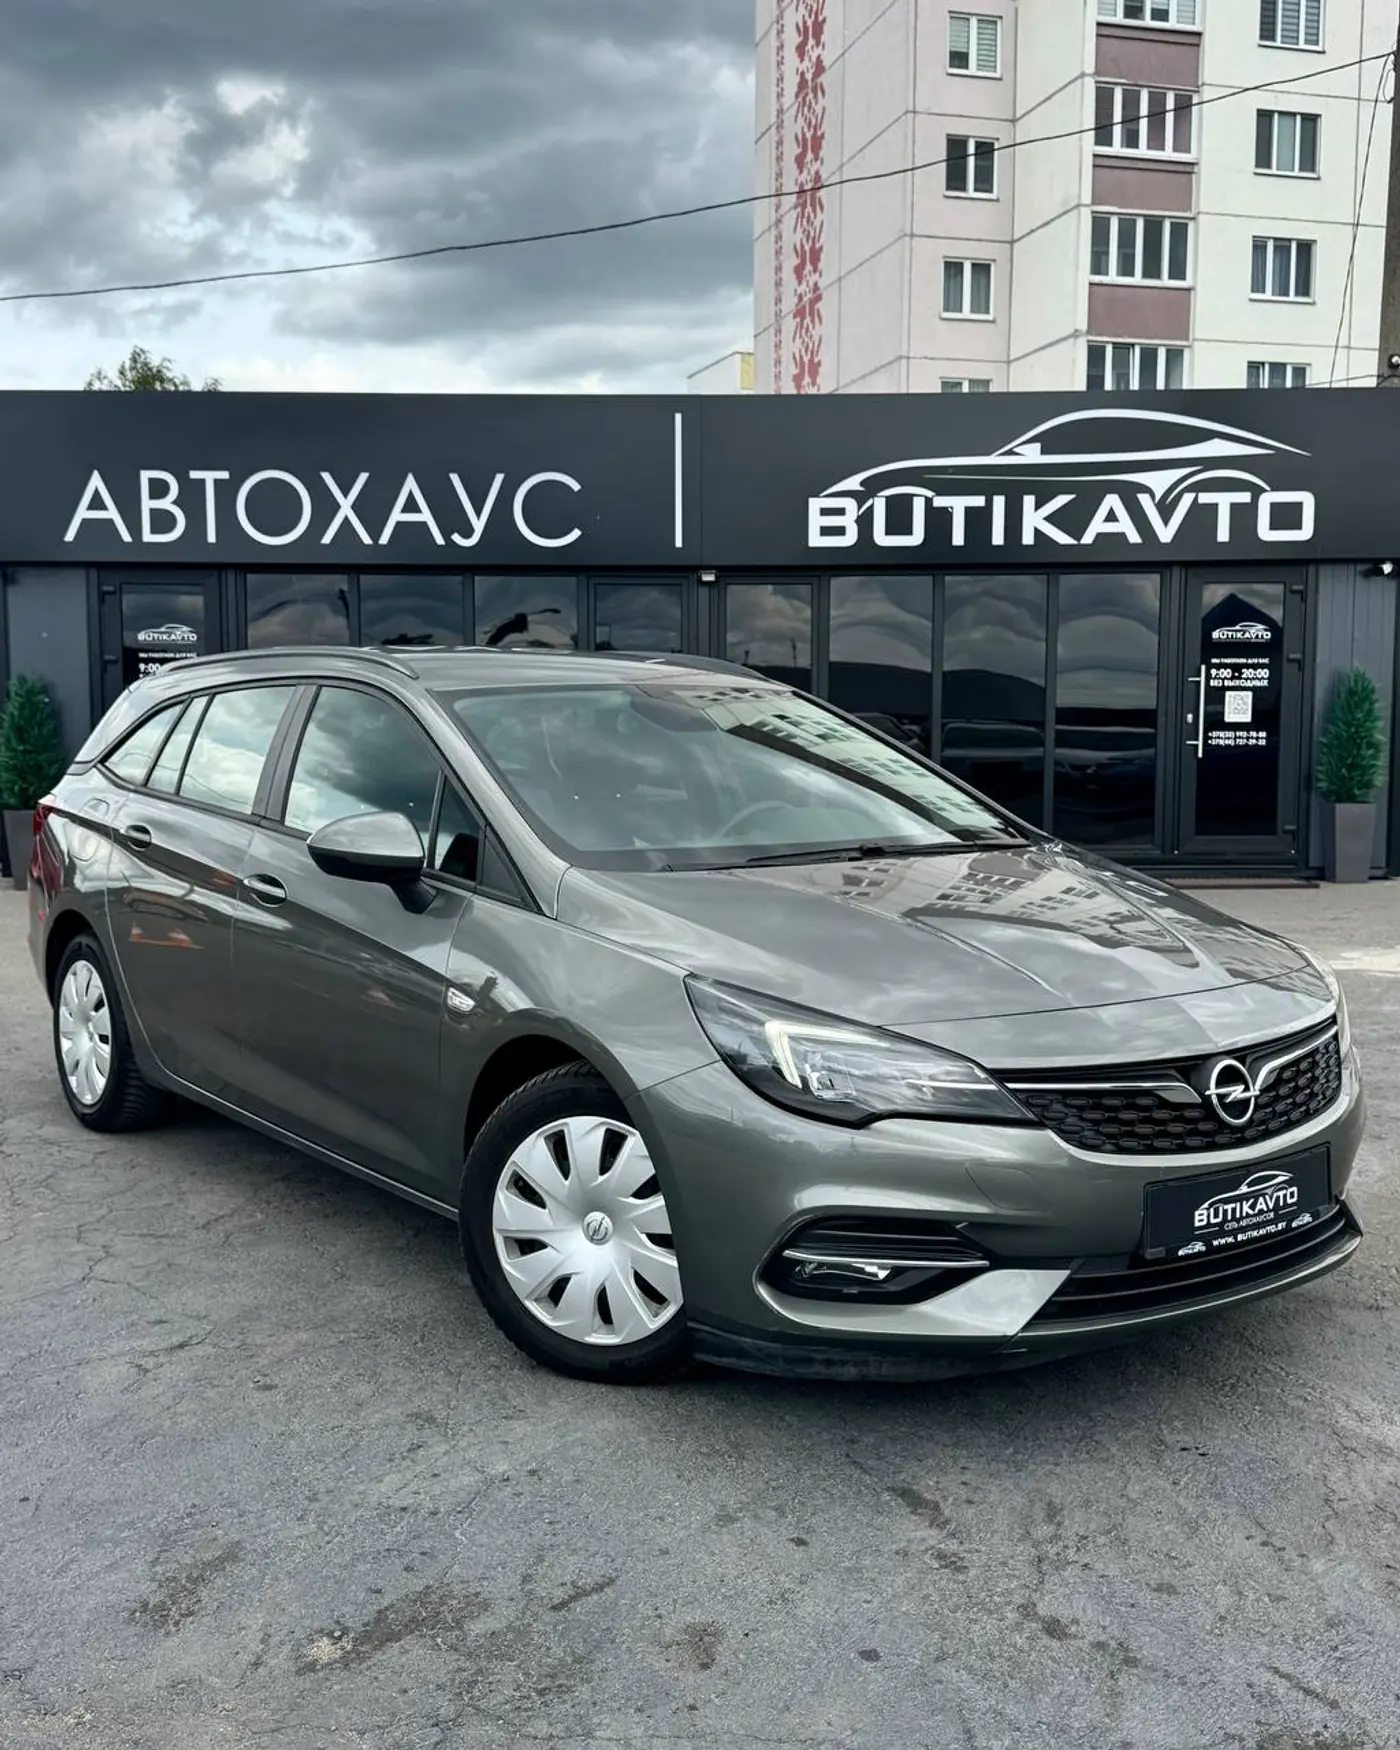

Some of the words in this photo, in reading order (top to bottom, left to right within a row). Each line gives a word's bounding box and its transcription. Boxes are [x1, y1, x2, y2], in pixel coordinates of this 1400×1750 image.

[64, 469, 582, 548] АВТОХАУС
[807, 490, 1316, 548] BUTIKAVTO
[138, 633, 198, 641] BUTIKAVTO
[1211, 631, 1271, 639] BUTIKAVTO
[139, 662, 161, 673] 9:00
[1210, 668, 1232, 679] 9:00
[1241, 668, 1270, 679] 20:00
[1210, 679, 1223, 687] БЕЗ
[1224, 679, 1269, 688] ВЫХОДНЫХ
[1194, 1187, 1298, 1227] BUTIKAVTO
